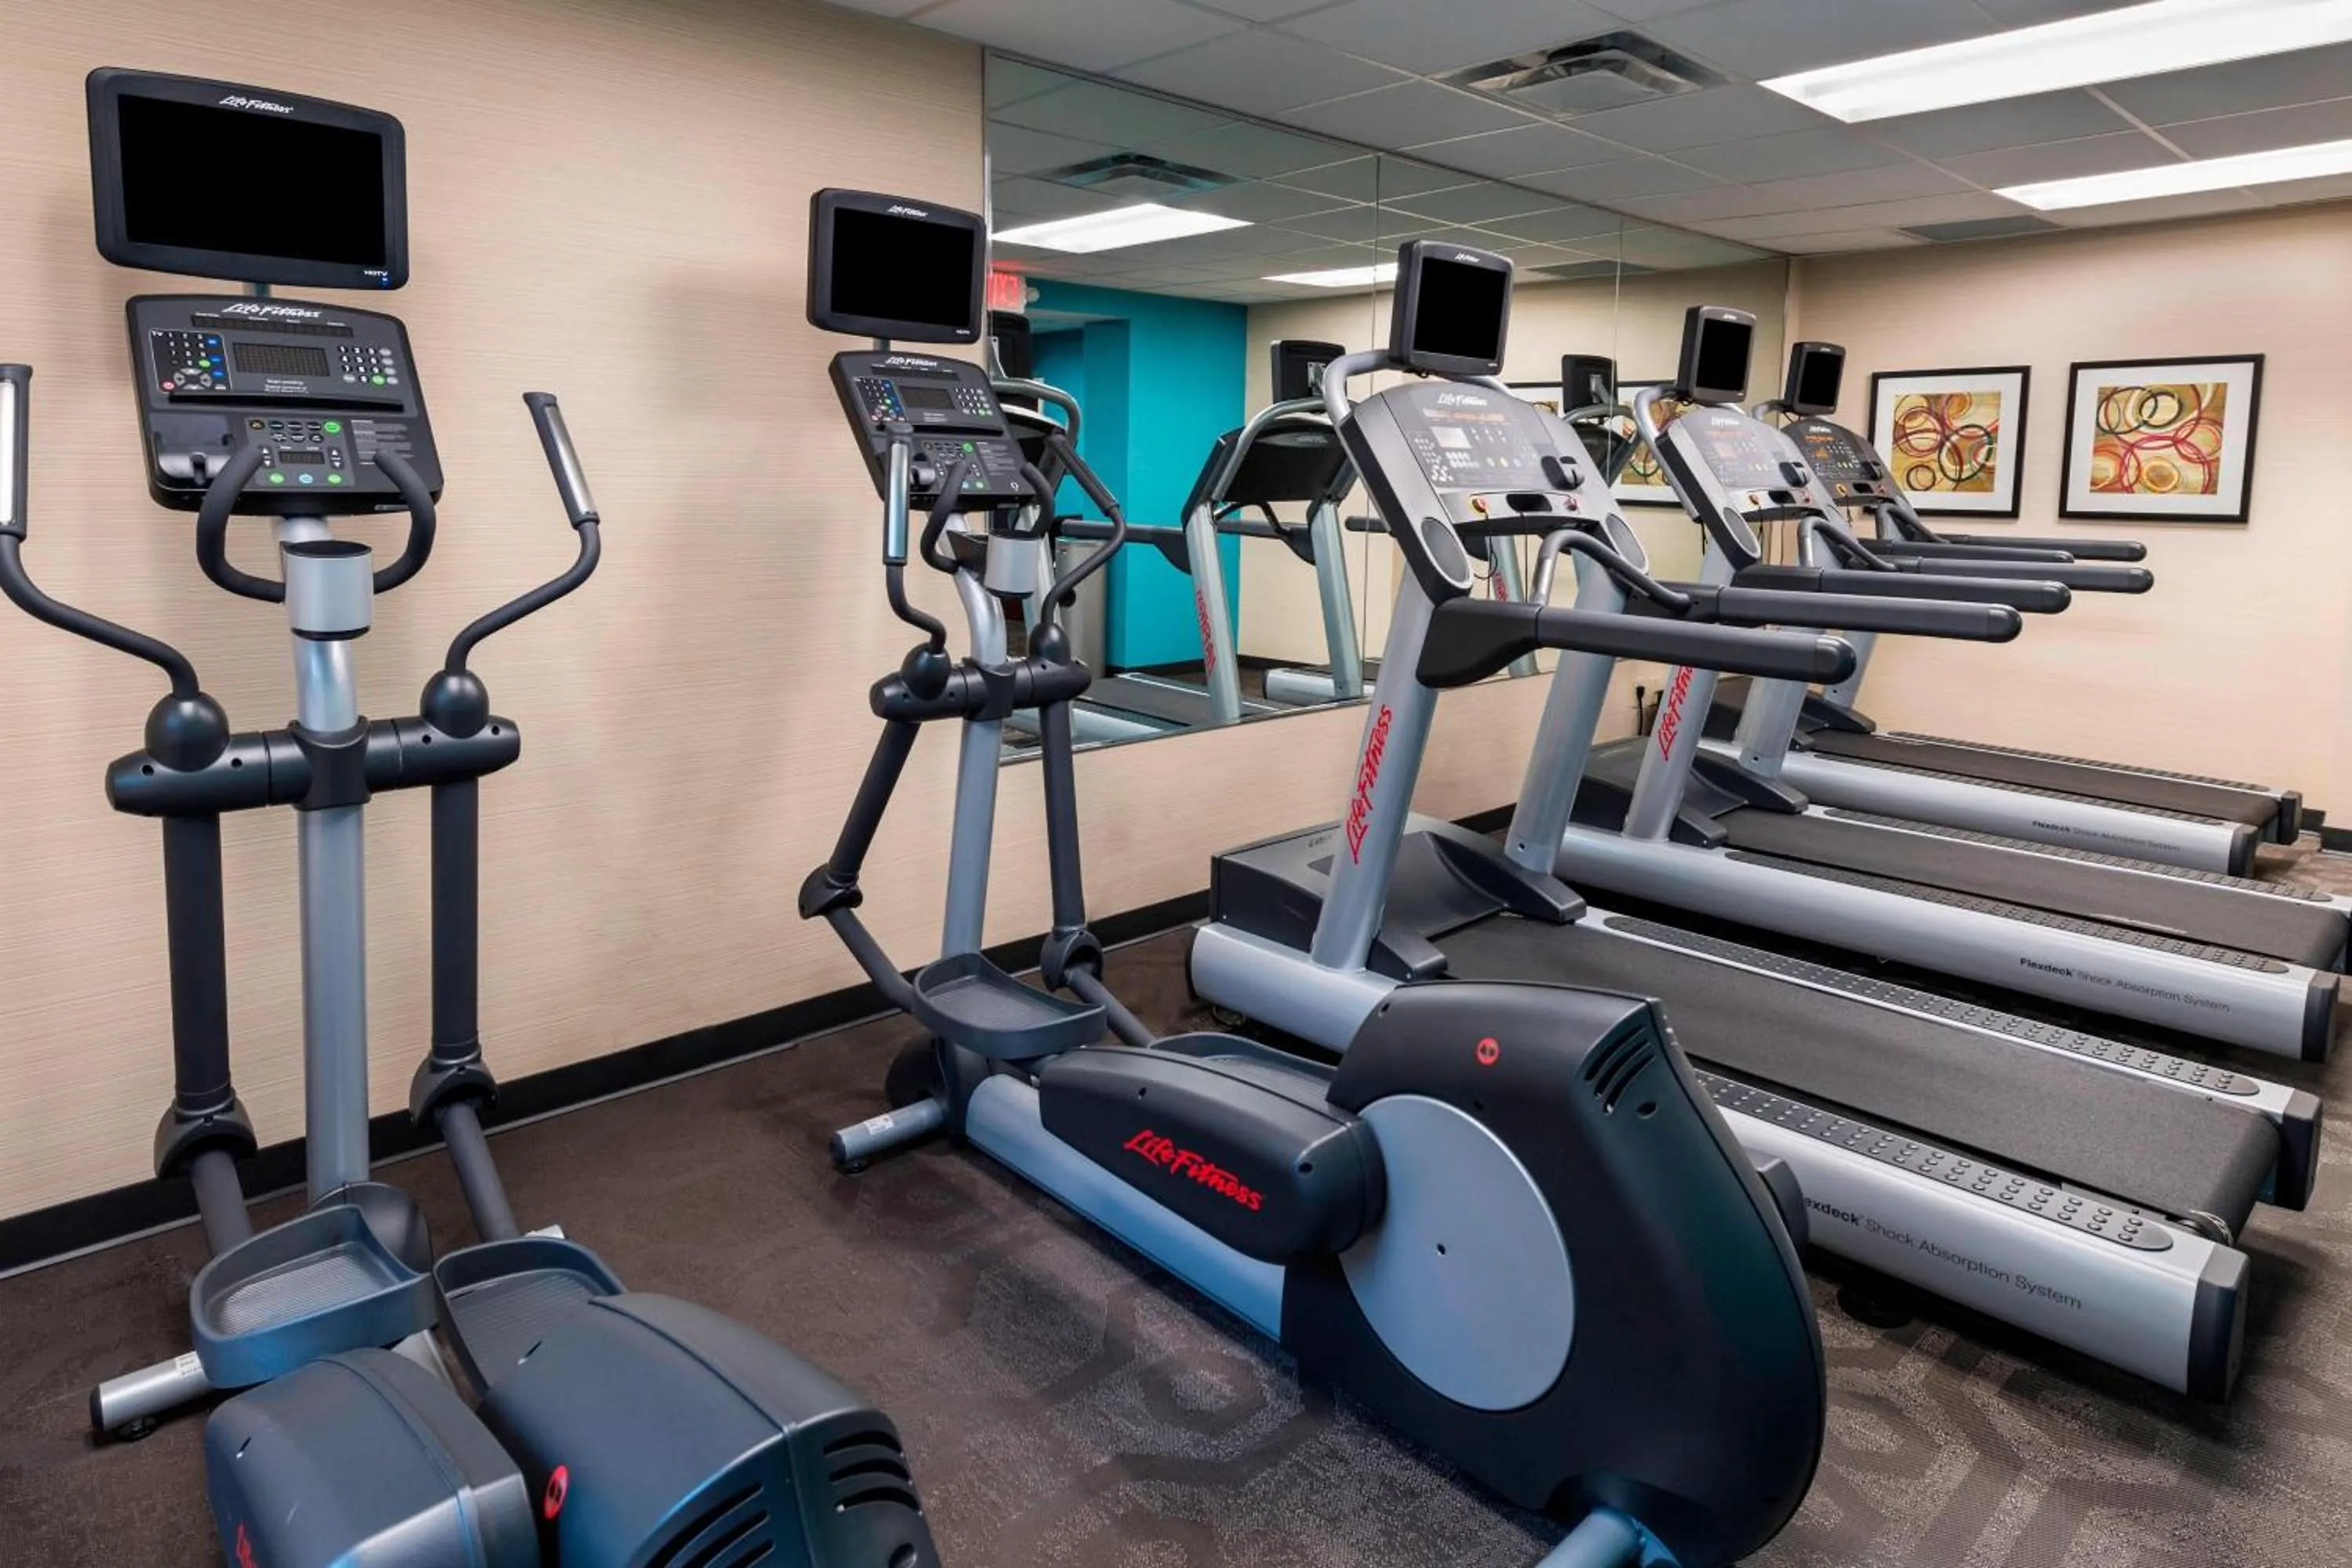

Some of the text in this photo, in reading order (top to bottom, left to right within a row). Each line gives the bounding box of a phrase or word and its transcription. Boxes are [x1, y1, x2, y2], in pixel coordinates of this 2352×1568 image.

[2115, 979, 2181, 1002] Absorption
[1803, 1197, 2082, 1308] exdeck Shock Absorption System
